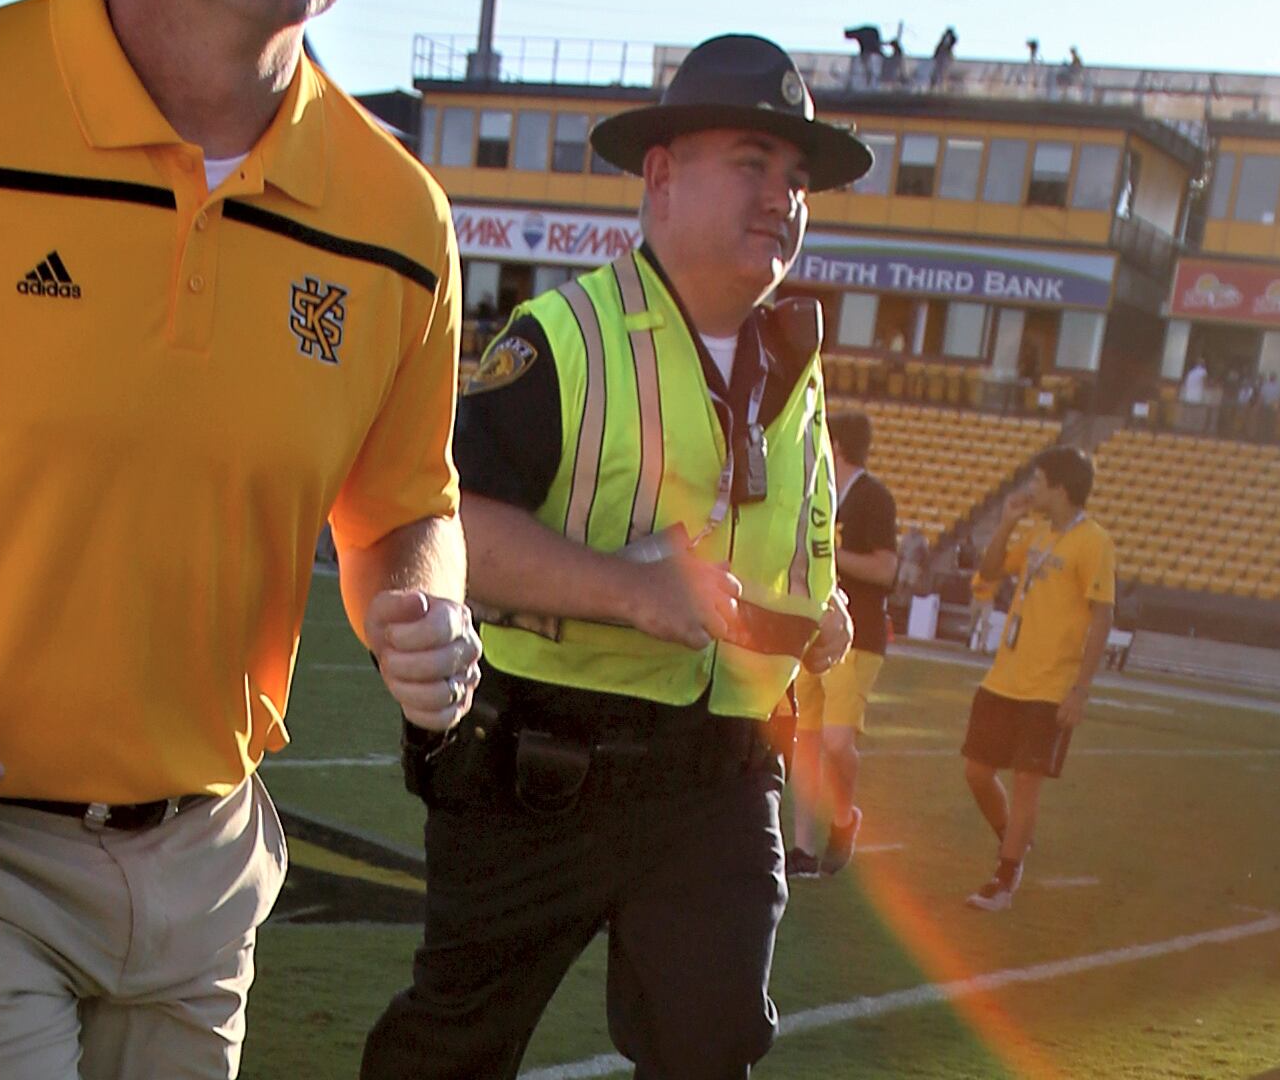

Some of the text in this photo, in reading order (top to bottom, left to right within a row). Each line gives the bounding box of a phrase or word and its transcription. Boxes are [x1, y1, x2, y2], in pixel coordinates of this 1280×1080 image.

[16, 280, 82, 299] adidas
[804, 255, 1064, 300] FIFTH THIRD BANK
